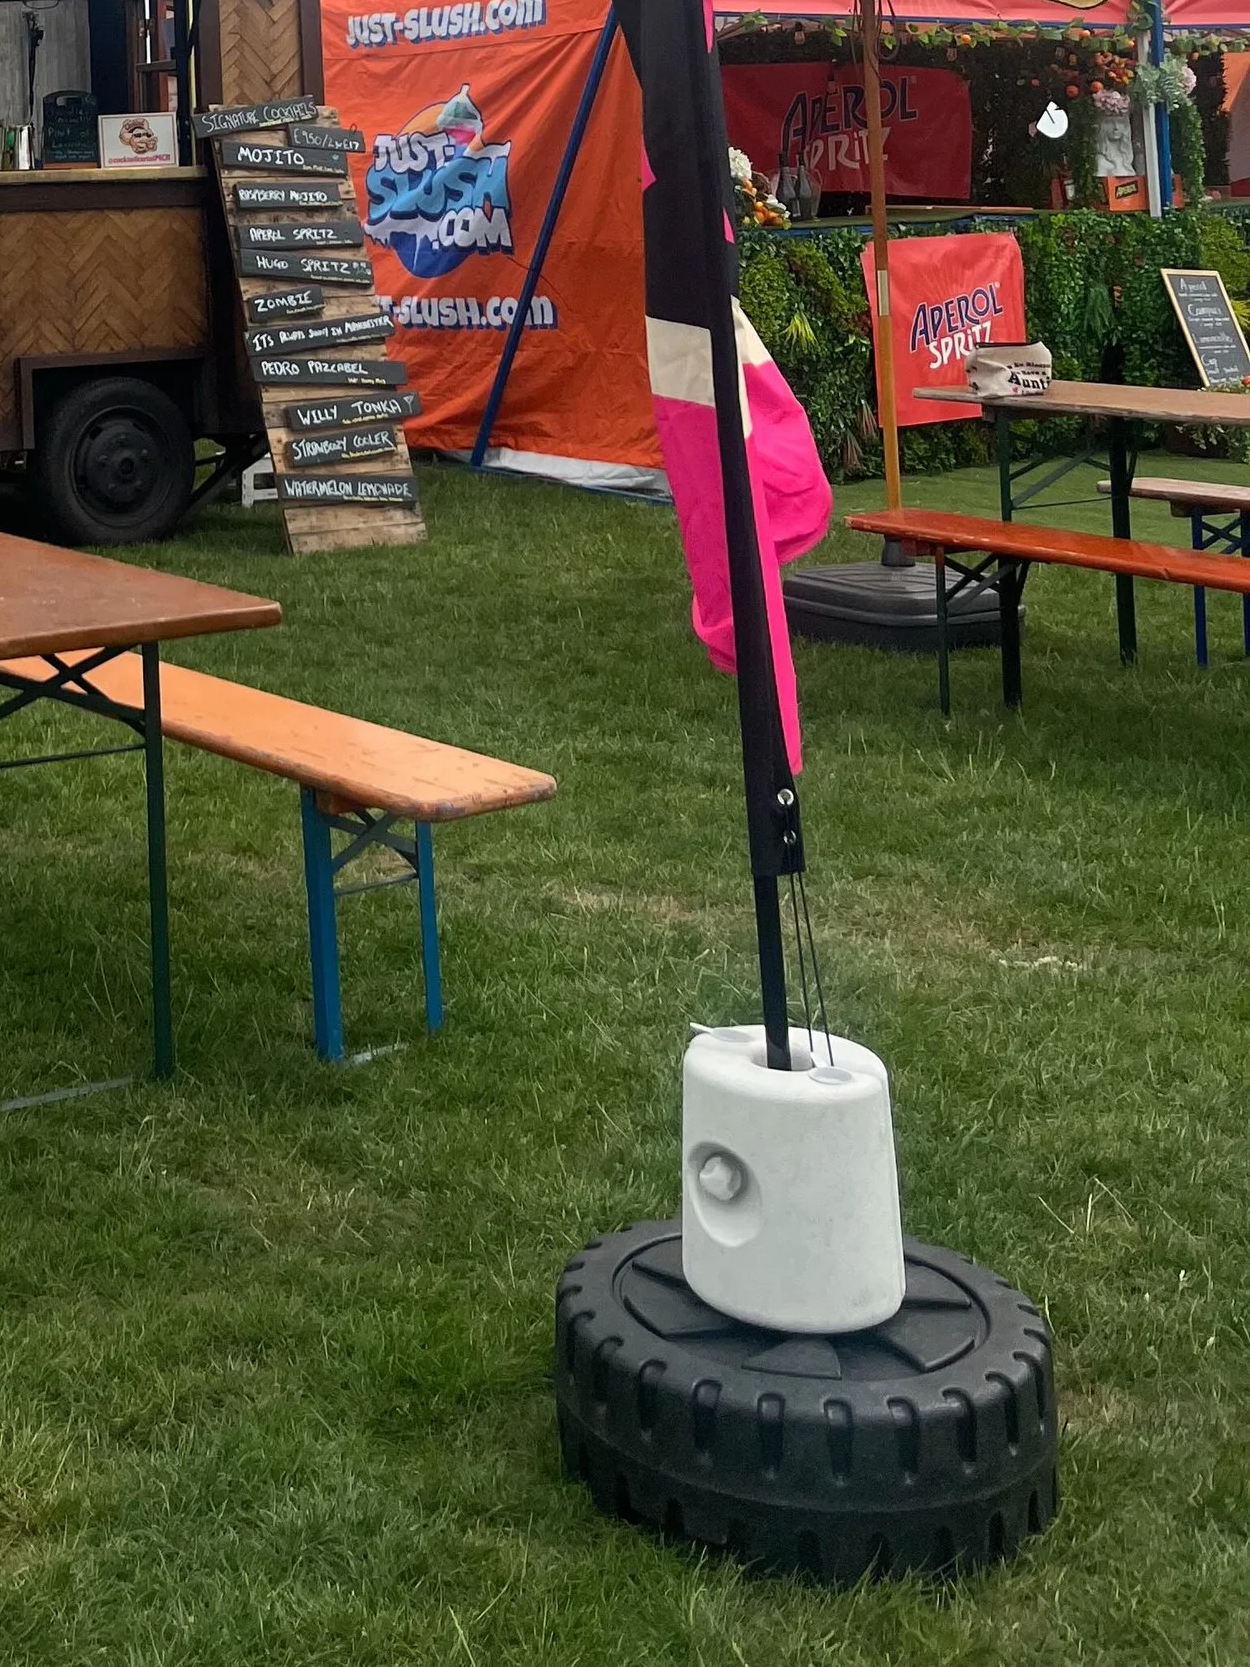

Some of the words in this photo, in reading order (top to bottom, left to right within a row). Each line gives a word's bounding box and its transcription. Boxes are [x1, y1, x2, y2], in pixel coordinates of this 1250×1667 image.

[237, 146, 304, 165] MOJITO
[366, 154, 510, 224] SLUSH
[250, 227, 286, 242] APEROL
[293, 227, 338, 241] SPRITZ
[256, 255, 289, 270] HUGO
[300, 258, 351, 274] SPRITZ
[254, 290, 312, 313] ZOMBIE
[910, 283, 1004, 354] APEROL
[261, 361, 300, 376] PEDRO
[297, 404, 338, 426] WILLY
[350, 399, 402, 415] TONKA
[284, 479, 352, 498] WATERMELON
